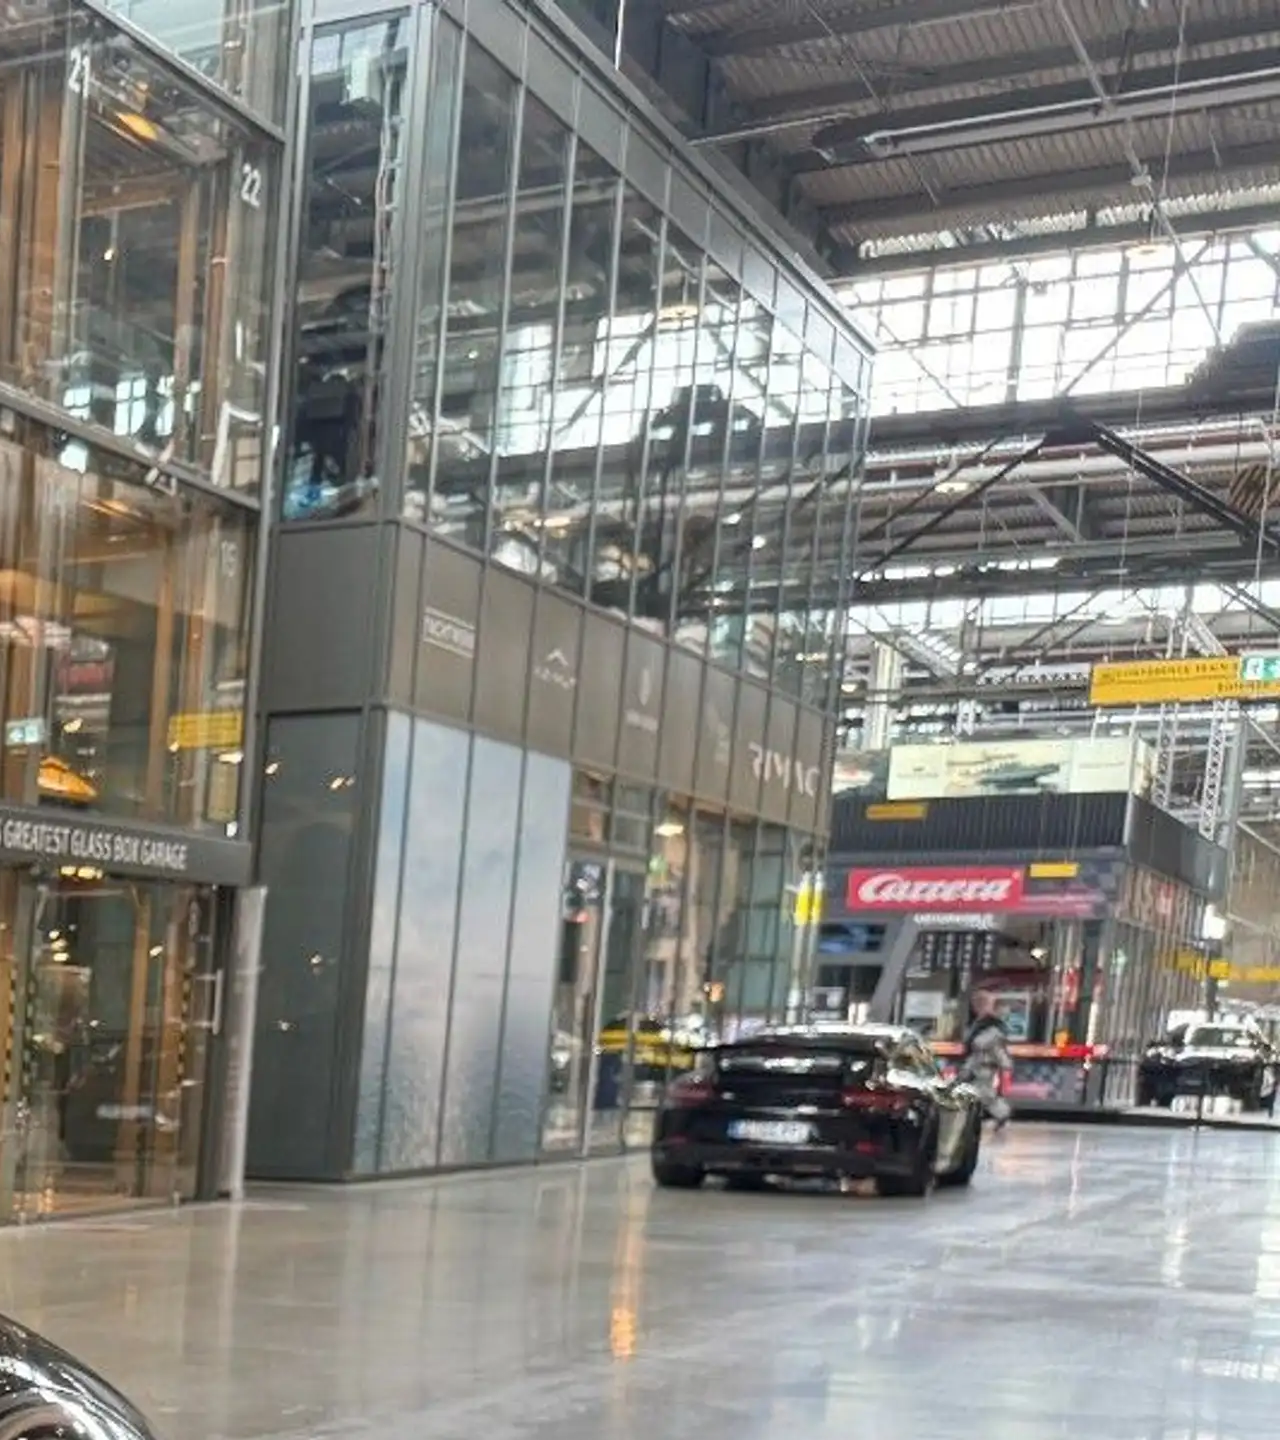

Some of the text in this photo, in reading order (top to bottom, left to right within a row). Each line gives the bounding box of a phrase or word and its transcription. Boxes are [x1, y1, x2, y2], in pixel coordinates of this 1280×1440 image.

[241, 163, 261, 208] 22
[3, 820, 70, 855] GREATEST
[71, 829, 111, 860] GLASS
[114, 834, 140, 863] BOX
[141, 838, 187, 870] GARAGE
[858, 873, 1013, 902] Carrera
